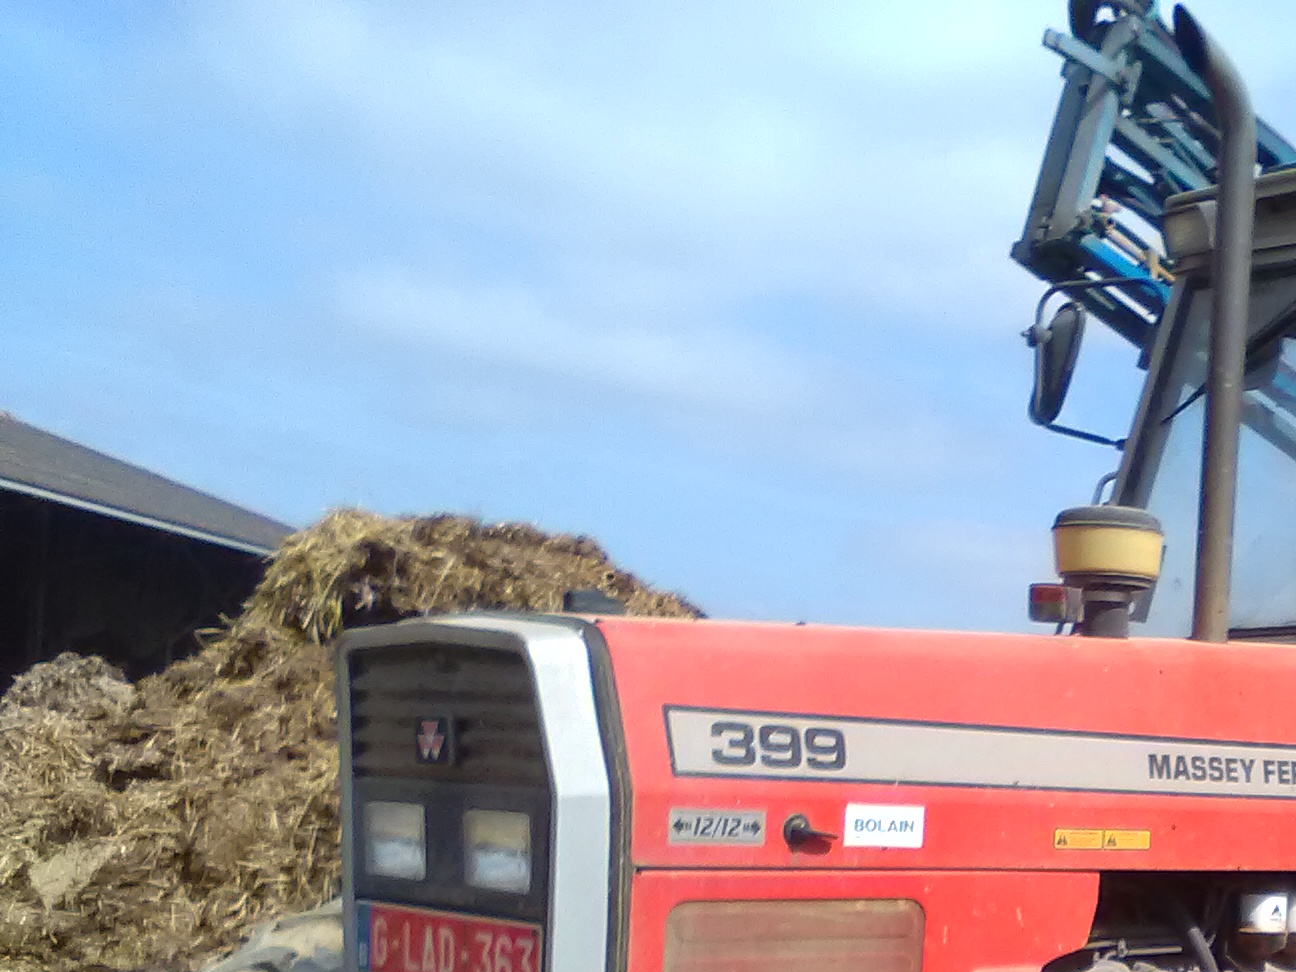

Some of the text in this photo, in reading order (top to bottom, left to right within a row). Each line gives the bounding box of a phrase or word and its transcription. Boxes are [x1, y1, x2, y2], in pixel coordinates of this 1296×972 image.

[710, 720, 847, 771] 399
[1147, 753, 1255, 784] MASSEY
[692, 815, 743, 838] 12/12
[853, 817, 916, 834] BOLAIN
